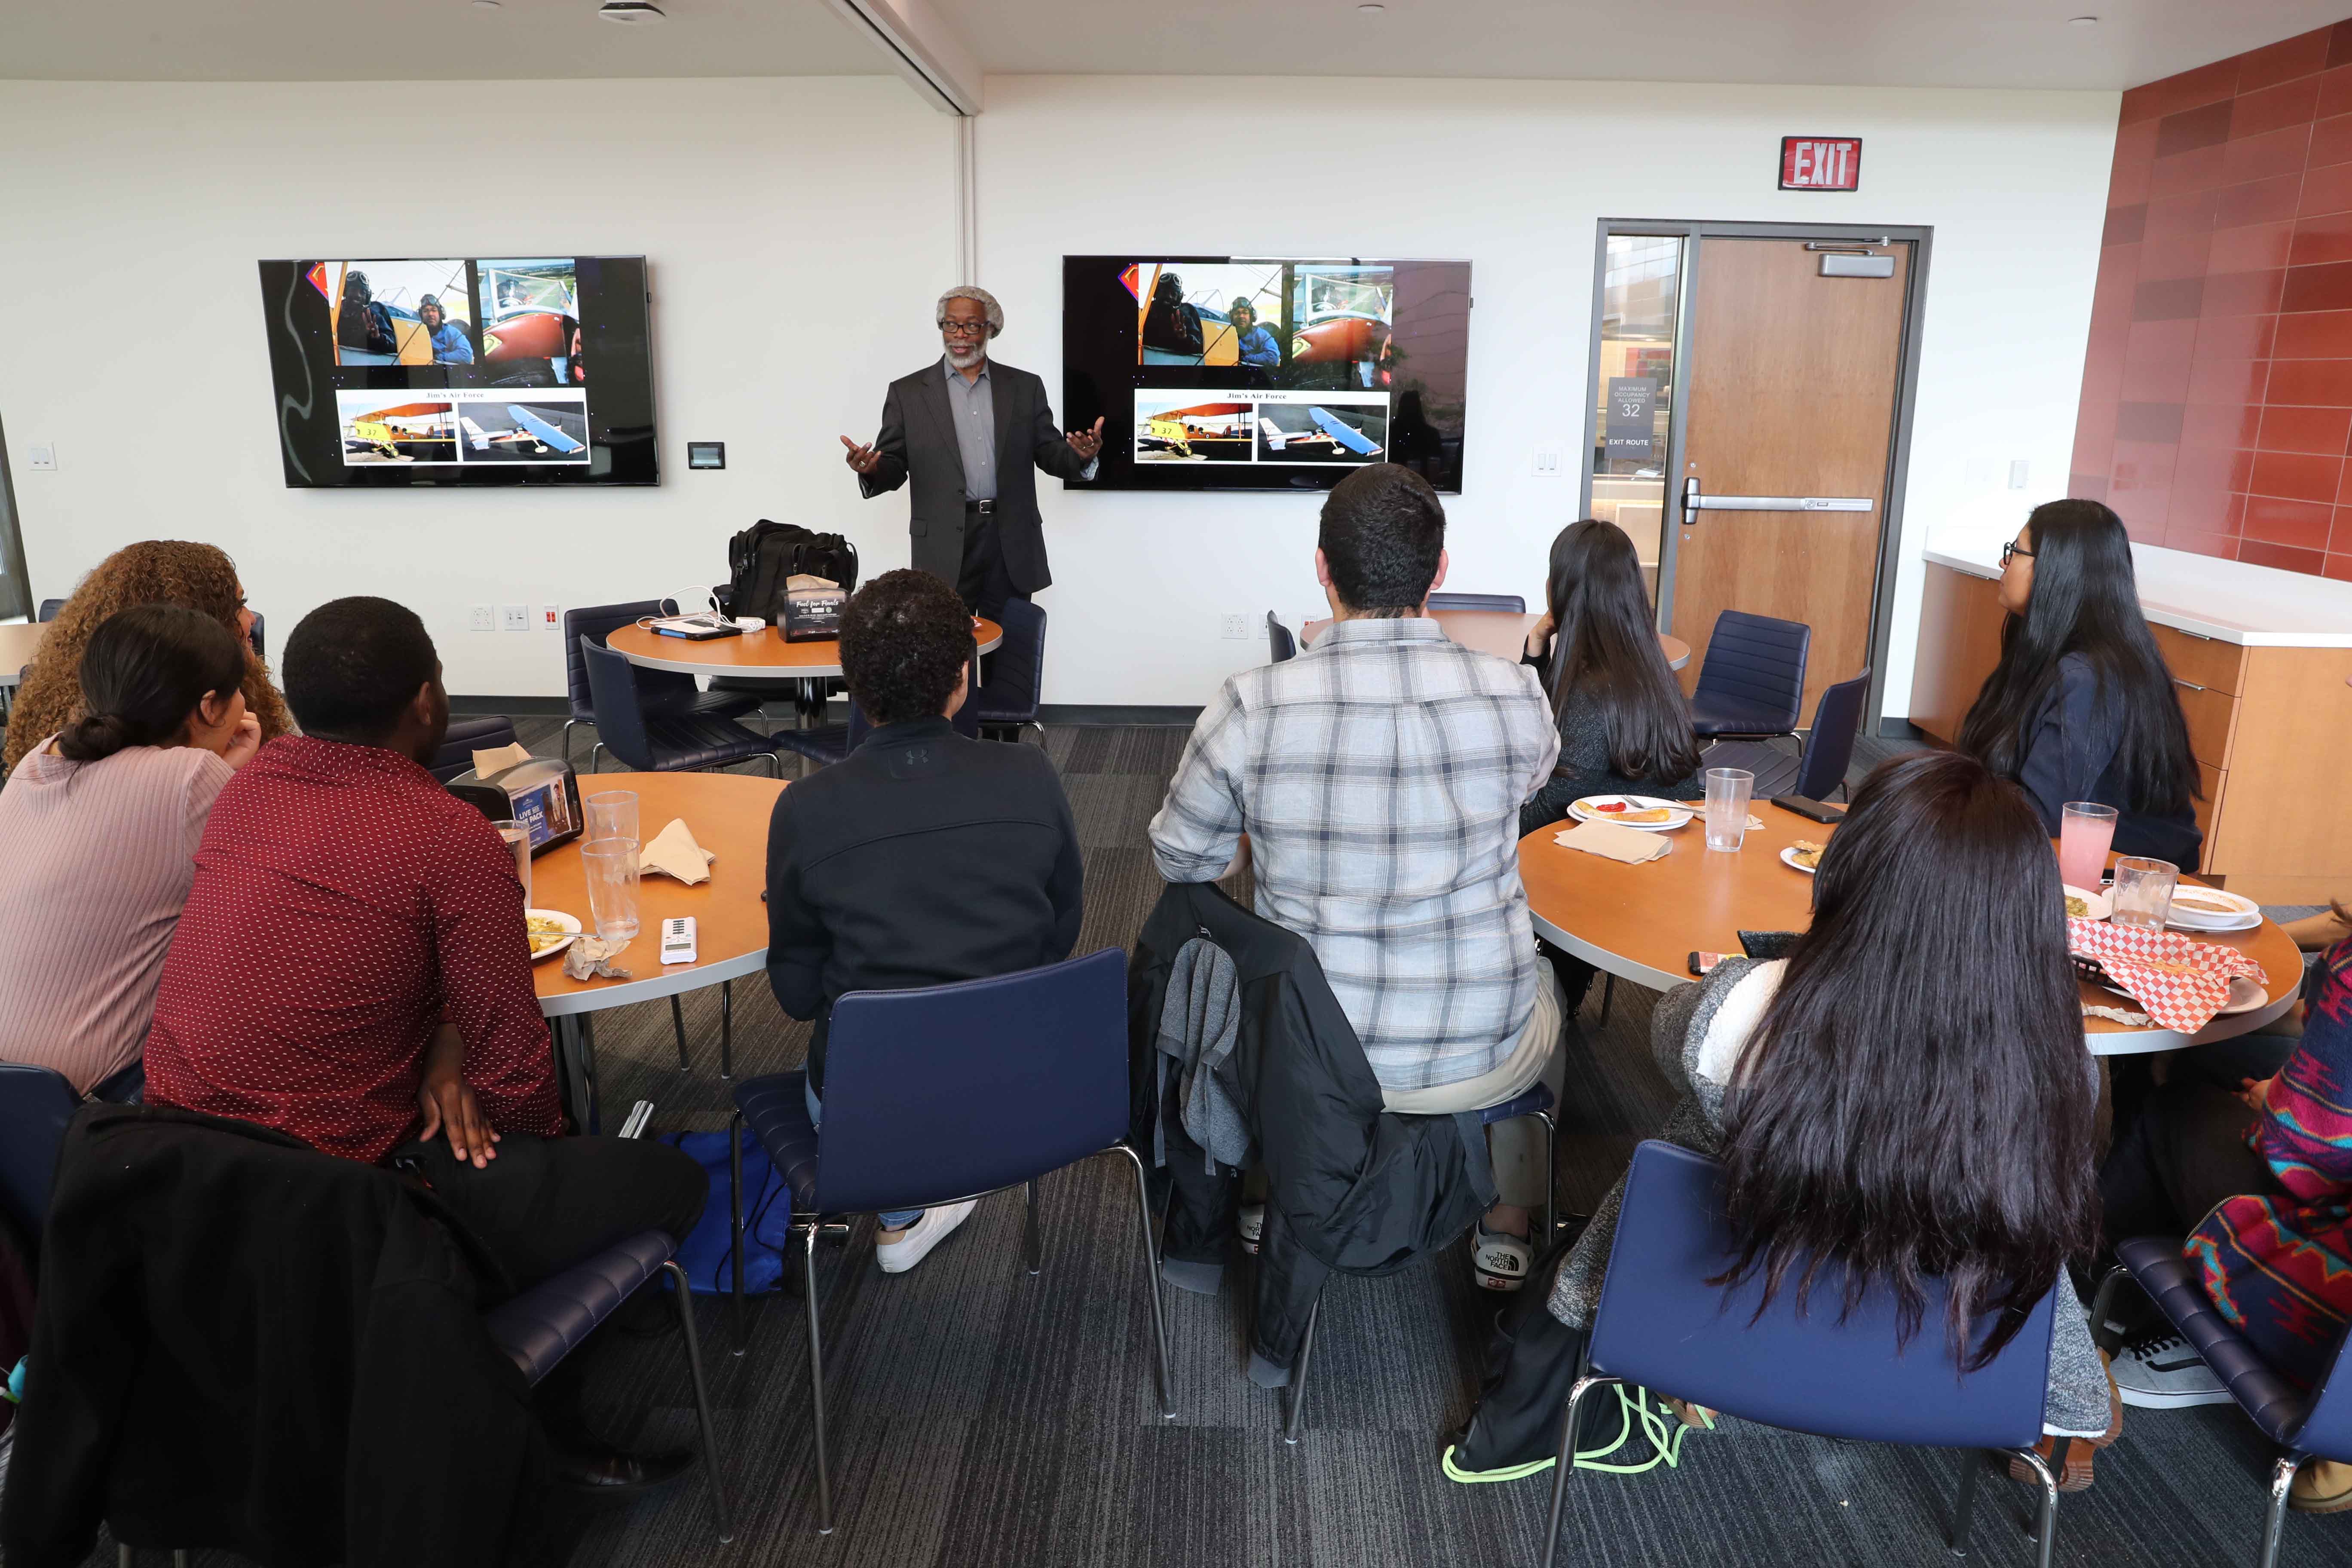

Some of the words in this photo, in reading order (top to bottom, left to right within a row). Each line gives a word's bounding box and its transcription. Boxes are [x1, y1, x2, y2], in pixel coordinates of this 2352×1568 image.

[1794, 142, 1852, 186] EXIT
[1622, 404, 1640, 417] 32
[796, 600, 809, 608] Fuel
[821, 598, 839, 606] Finals
[519, 809, 532, 820] LIVE
[529, 811, 544, 823] PACK
[1485, 1254, 1509, 1265] NORTH
[1490, 1262, 1508, 1270] FACE
